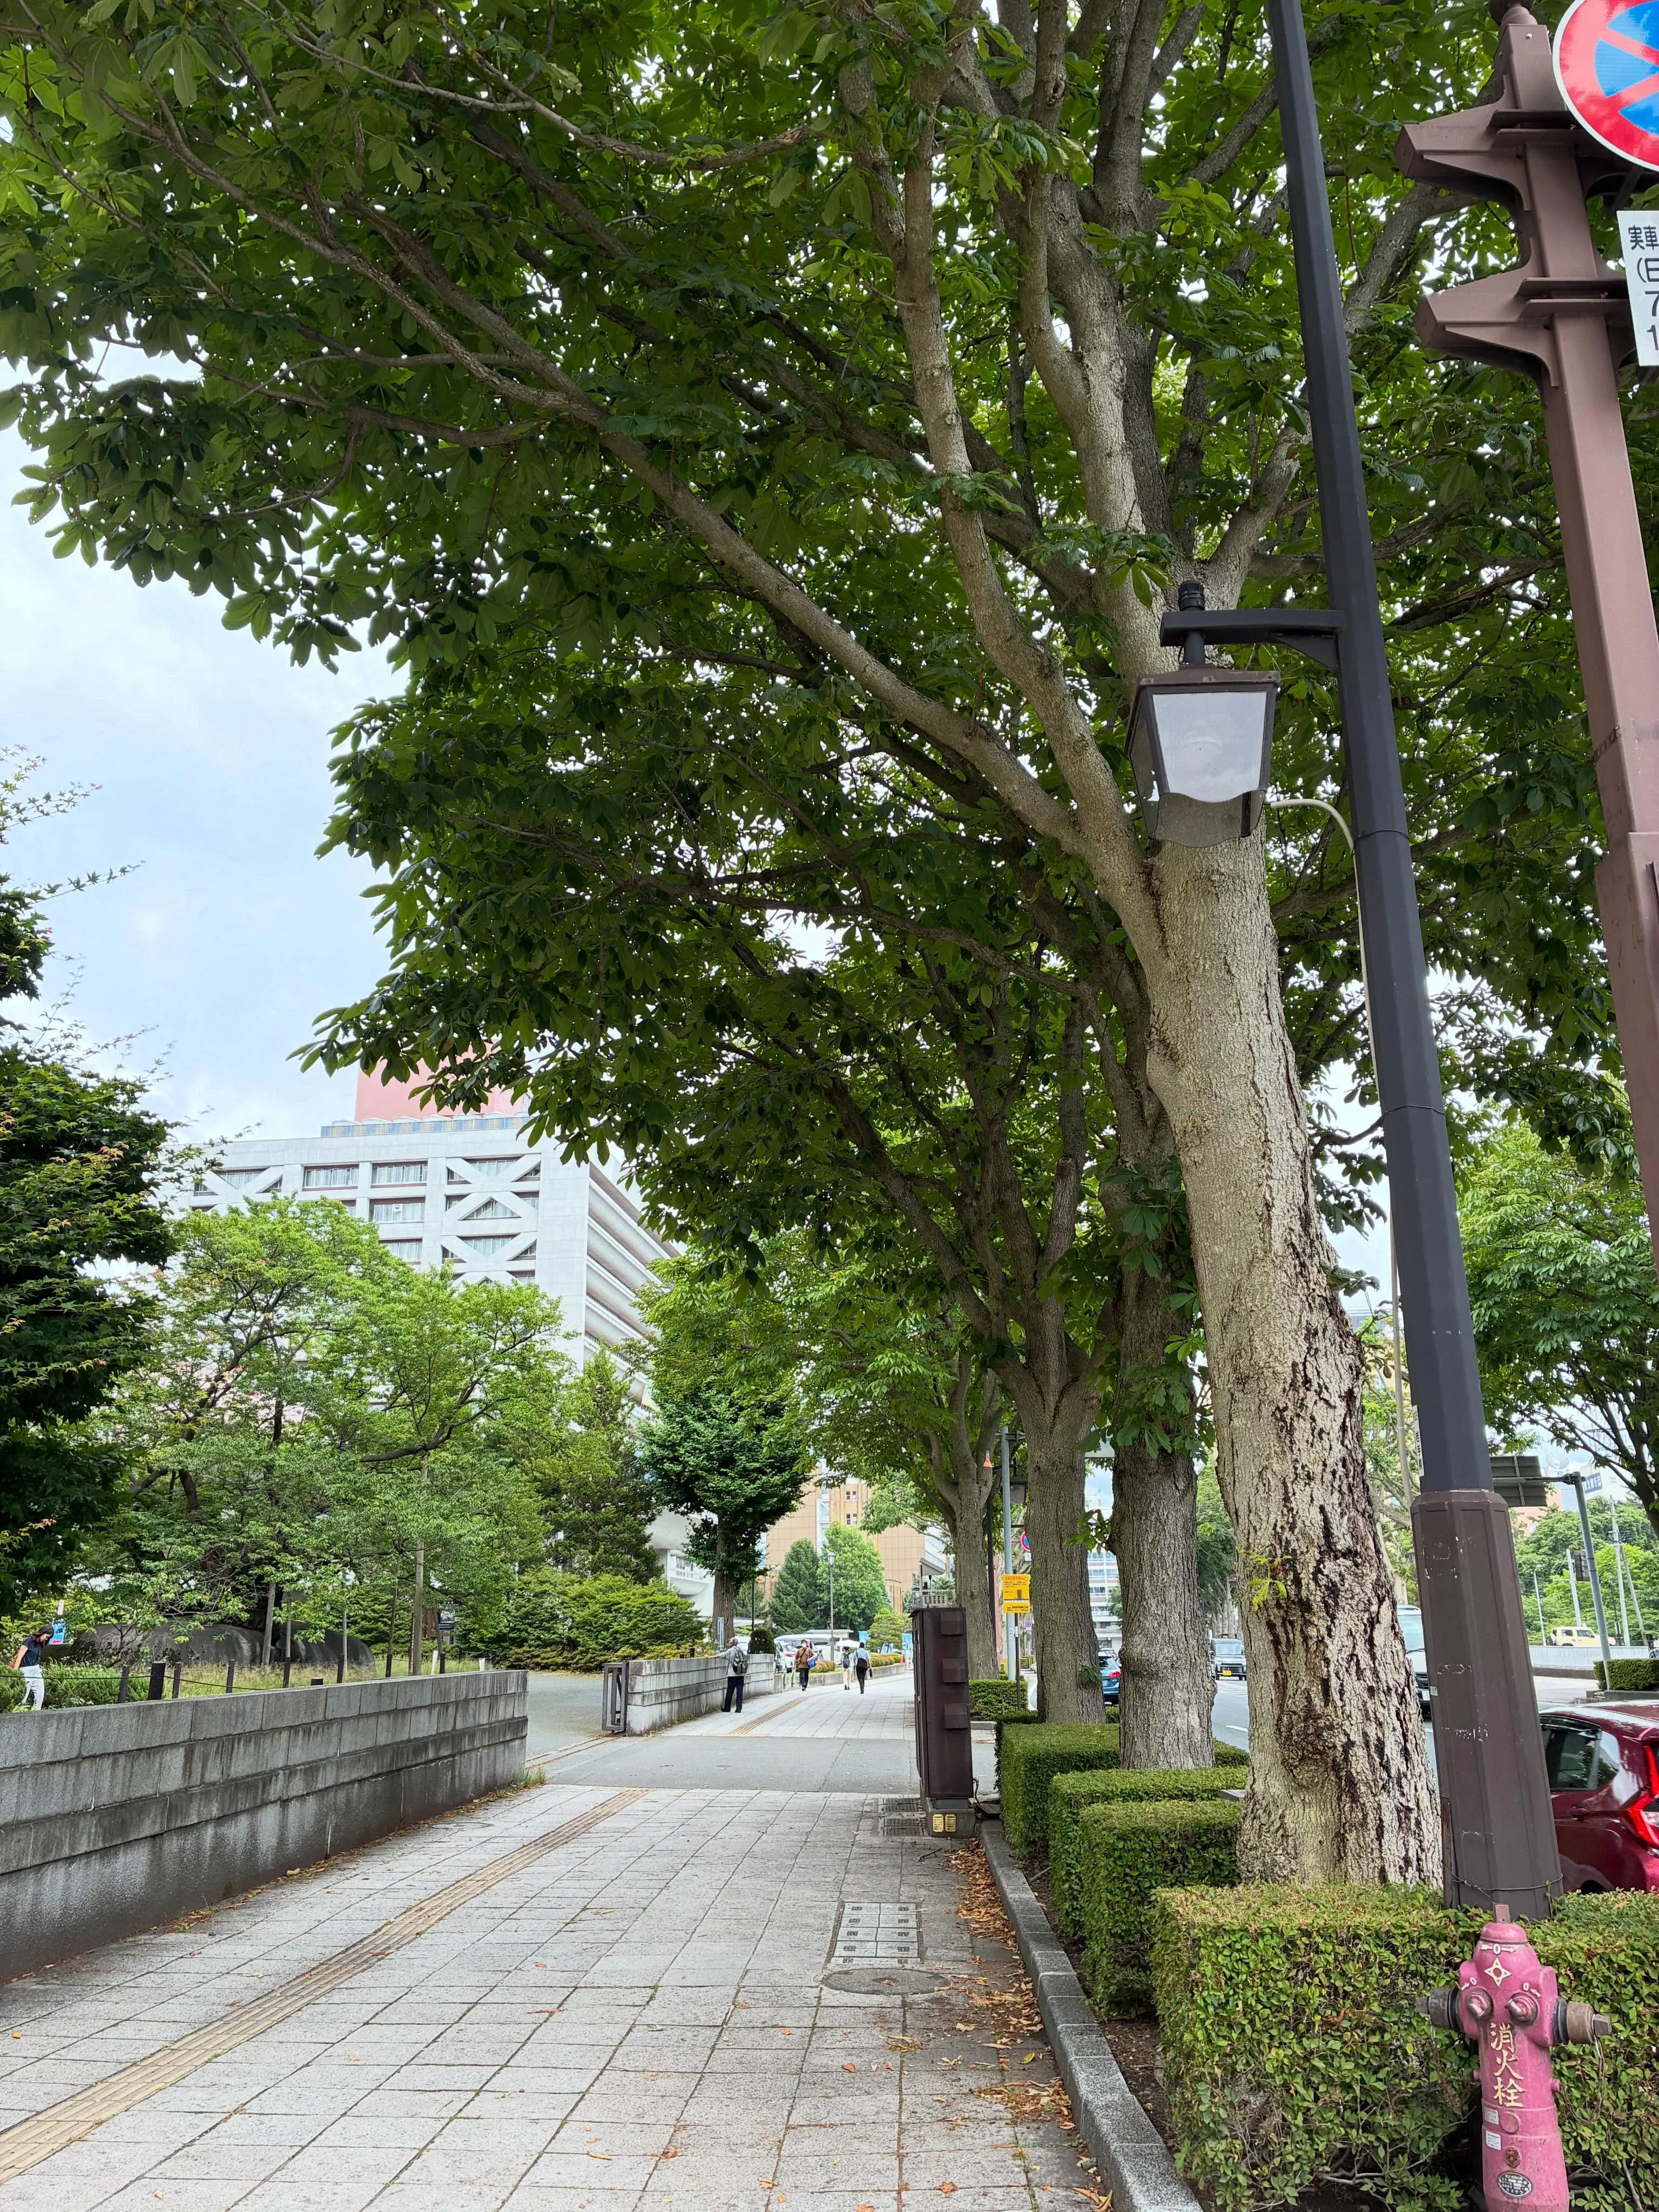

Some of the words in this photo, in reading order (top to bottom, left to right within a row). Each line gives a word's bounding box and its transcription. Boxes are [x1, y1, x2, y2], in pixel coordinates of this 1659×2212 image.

[1628, 225, 1659, 251] 実車
[1490, 2022, 1525, 2108] 消火栓
